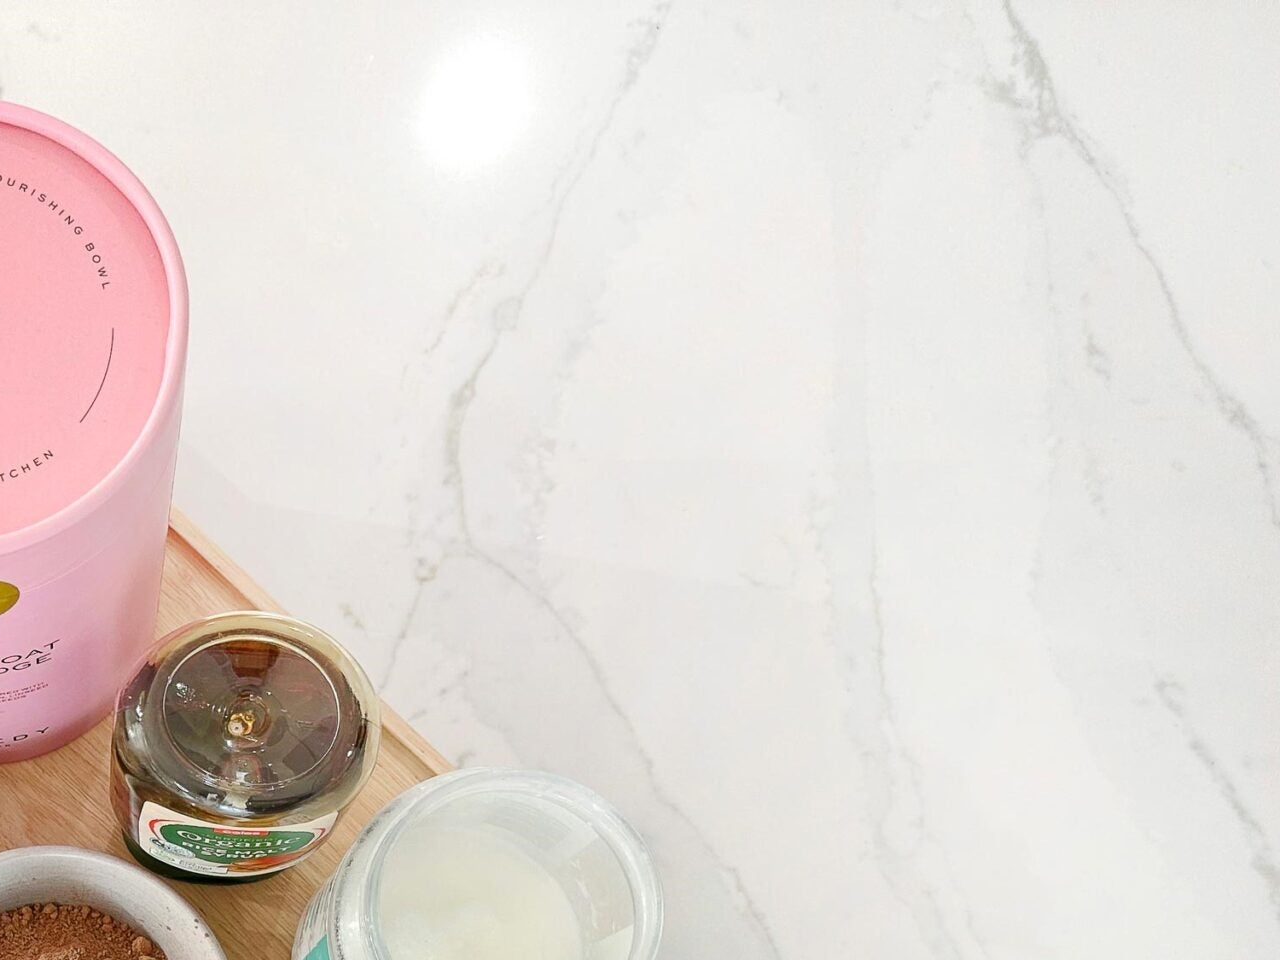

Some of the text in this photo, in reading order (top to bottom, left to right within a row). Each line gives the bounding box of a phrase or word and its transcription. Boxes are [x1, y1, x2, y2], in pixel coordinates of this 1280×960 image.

[85, 243, 110, 290] BOWL
[1, 639, 61, 664] OAT
[177, 831, 300, 847] Organic
